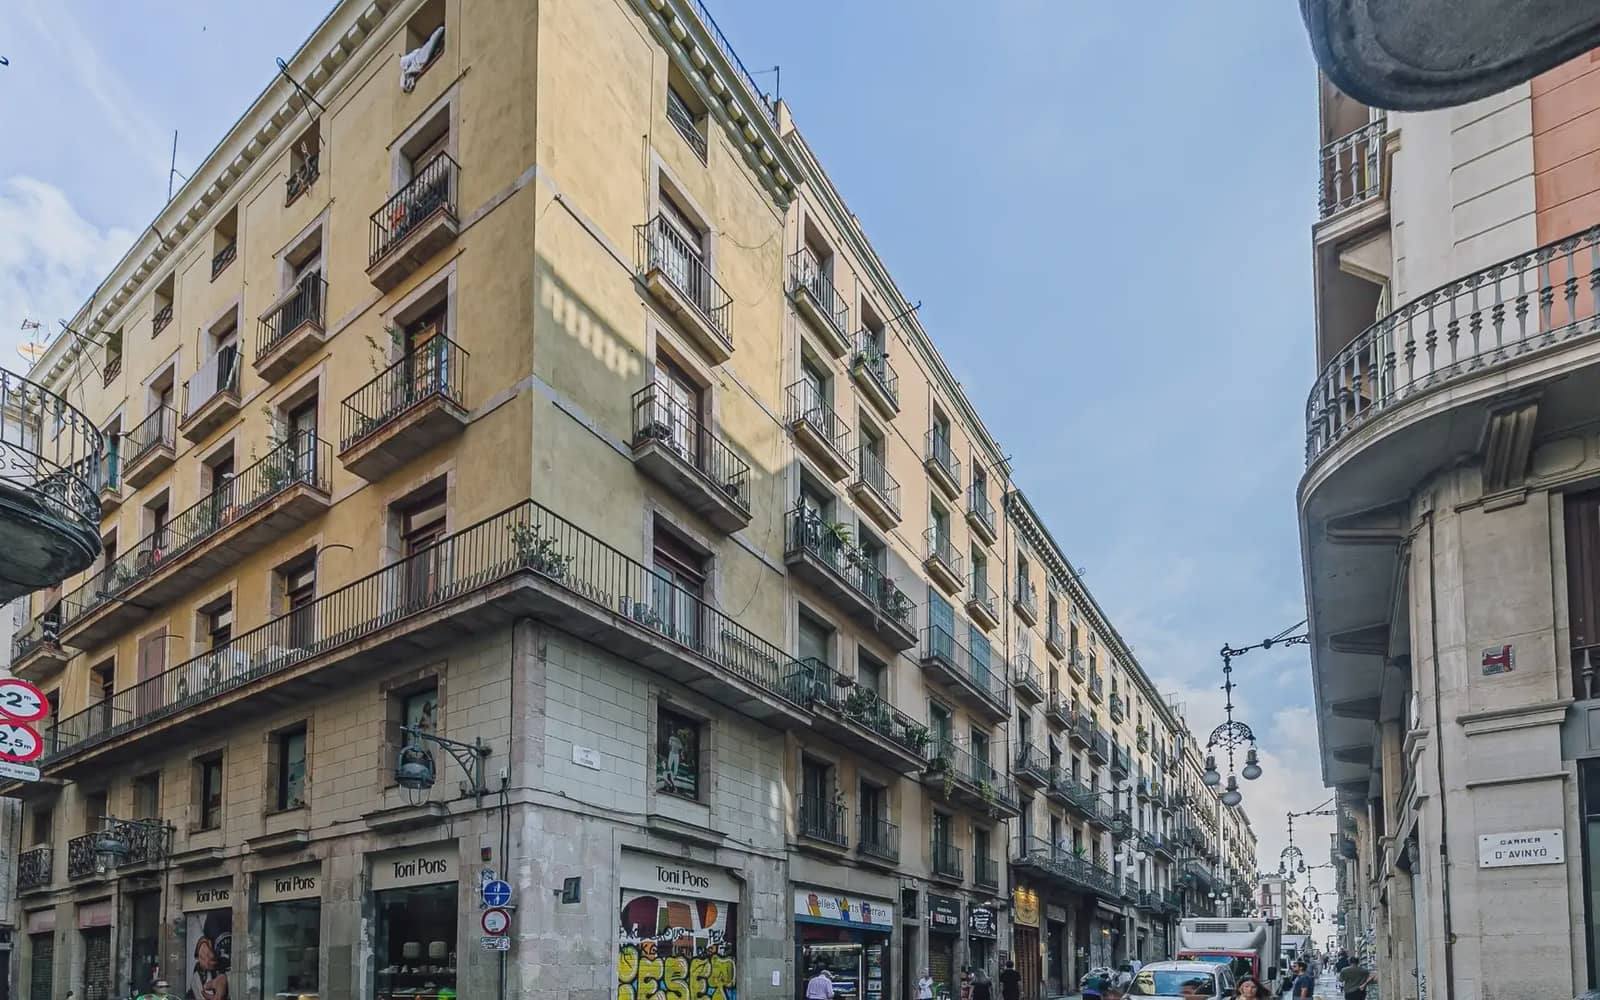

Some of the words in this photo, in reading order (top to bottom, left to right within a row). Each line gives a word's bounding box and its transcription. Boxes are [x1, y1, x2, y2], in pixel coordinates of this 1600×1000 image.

[6, 691, 22, 708] 2
[1500, 837, 1541, 846] CARRER
[393, 861, 415, 879] Toni
[418, 858, 447, 876] Pons
[656, 866, 680, 884] Toni
[682, 870, 709, 888] Pons
[274, 879, 291, 894] Toni
[293, 876, 315, 892] Pons
[195, 889, 210, 904] Toni
[211, 888, 229, 902] Pons
